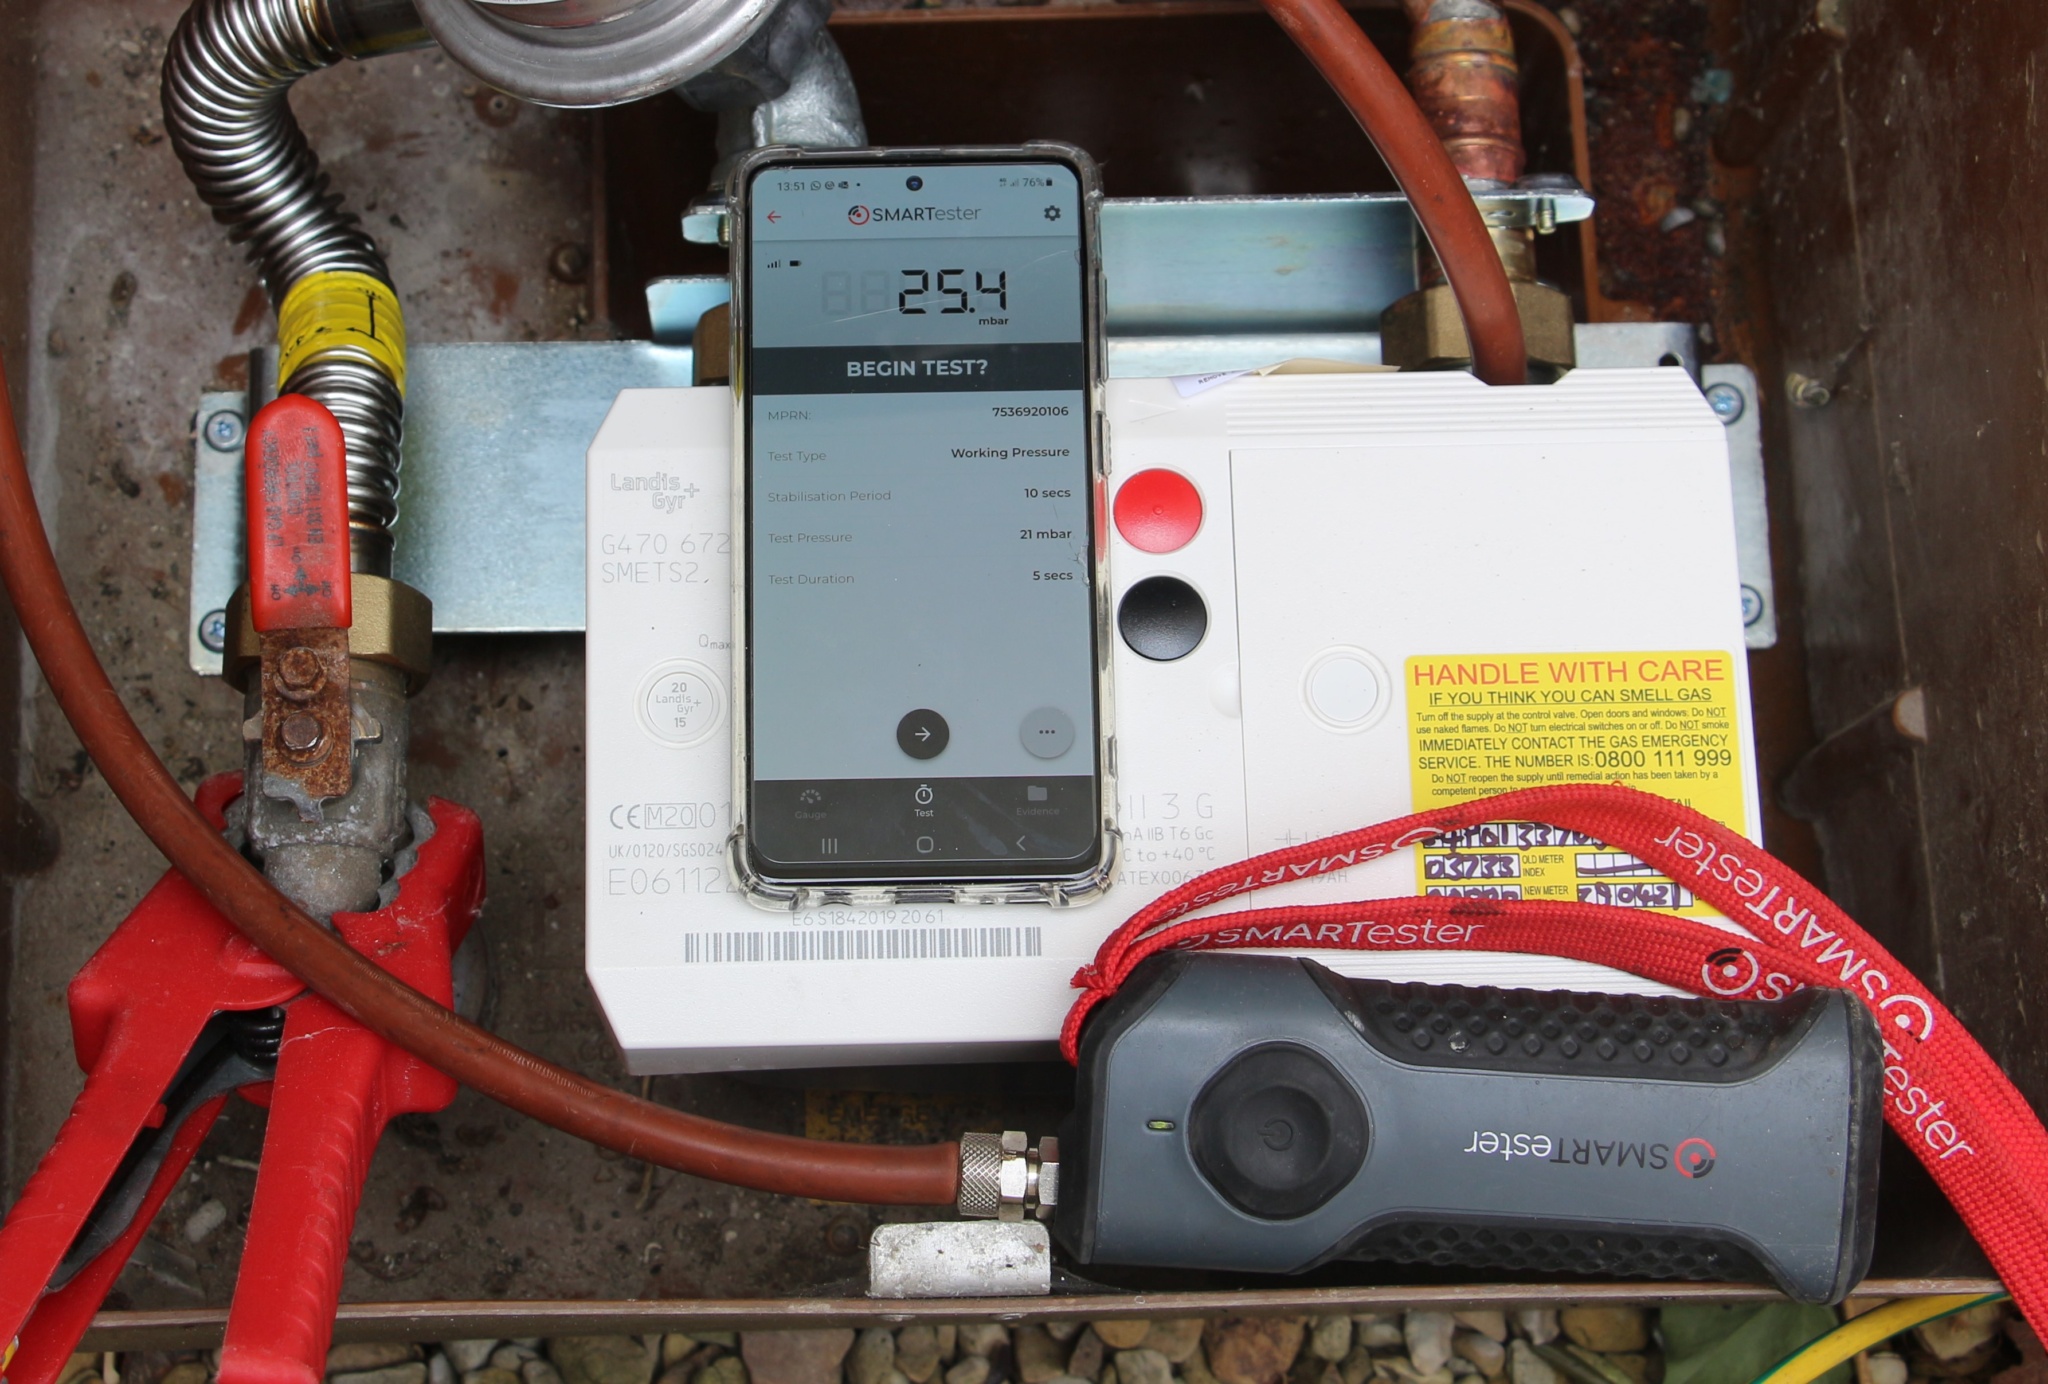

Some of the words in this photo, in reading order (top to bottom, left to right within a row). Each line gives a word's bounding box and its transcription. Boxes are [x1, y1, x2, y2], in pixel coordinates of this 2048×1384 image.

[777, 181, 806, 191] 13:51
[1022, 178, 1045, 187] 76%
[872, 206, 981, 222] SMARTester
[899, 269, 1007, 314] 25.4
[979, 317, 1009, 326] mbar
[847, 361, 916, 377] BEGIN
[922, 359, 988, 376] TEST?
[768, 411, 812, 420] MPRN:
[992, 407, 1069, 417] 7536920106
[768, 452, 794, 462] Test
[796, 451, 827, 463] Type
[951, 448, 1008, 460] Working
[1012, 447, 1070, 458] Pressure
[610, 472, 681, 491] Landis
[768, 492, 846, 502] Stabilisation
[850, 491, 891, 502] Period
[1024, 488, 1039, 498] 10
[1042, 490, 1071, 498] secs
[652, 492, 686, 514] Gyr
[768, 533, 795, 544] Test
[797, 532, 853, 543] Pressure
[1020, 530, 1033, 540] 21
[1036, 530, 1072, 539] mbar
[601, 533, 668, 555] G470
[768, 574, 795, 585] Test
[798, 573, 855, 584] Duration
[1033, 571, 1042, 581] 5
[1044, 572, 1073, 580] secs
[1414, 662, 1539, 686] HANDLE
[1549, 660, 1628, 684] WITH
[1638, 659, 1725, 682] CARE
[671, 682, 688, 693] 20
[656, 694, 692, 704] Landis
[1429, 692, 1443, 705] IF
[1448, 692, 1482, 705] YOU
[1488, 691, 1537, 704] THINK
[1540, 690, 1577, 704] YOU
[1581, 690, 1616, 703] CAN
[1620, 688, 1673, 702] SMELL
[1677, 688, 1712, 702] GAS
[1416, 712, 1435, 722] Turn
[1438, 712, 1448, 721] off
[1451, 712, 1464, 721] the
[1466, 712, 1494, 722] supply
[1496, 712, 1504, 720] at
[1506, 711, 1520, 720] the
[1522, 710, 1550, 720] control
[1552, 710, 1578, 719] valve.
[1580, 710, 1604, 719] Open
[1606, 709, 1630, 718] doors
[1632, 709, 1648, 718] and
[1692, 708, 1704, 716] Do
[1706, 707, 1726, 717] NOT
[674, 718, 687, 728] 15
[1416, 726, 1431, 734] use
[1434, 724, 1459, 734] naked
[1462, 724, 1491, 733] flames.
[1494, 724, 1506, 732] Do
[1508, 723, 1528, 732] NOT
[1530, 724, 1546, 732] turn
[1549, 722, 1586, 732] electrical
[1588, 722, 1624, 730] switches
[1626, 722, 1638, 730] on
[1640, 722, 1648, 730] or
[1650, 721, 1663, 730] off.
[1665, 720, 1678, 730] Do
[1680, 720, 1700, 730] NOT
[1702, 720, 1730, 728] smoke
[1419, 737, 1508, 752] IMMEDIATELY
[1512, 736, 1575, 750] CONTACT
[1579, 736, 1606, 748] THE
[1610, 735, 1638, 748] GAS
[1642, 734, 1728, 748] EMERGENCY
[1418, 756, 1481, 770] SERVICE.
[1484, 756, 1512, 768] THE
[1516, 754, 1574, 768] NUMBER
[1595, 750, 1646, 768] 0800
[1654, 750, 1685, 767] 111
[1694, 749, 1732, 766] 999
[1432, 774, 1444, 783] Do
[1446, 774, 1466, 784] NOT
[1468, 774, 1498, 784] reopen
[1500, 773, 1514, 782] the
[1516, 772, 1544, 783] supply
[1546, 772, 1564, 781] until
[1566, 772, 1603, 780] remedial
[1605, 772, 1630, 780] action
[1632, 771, 1648, 780] has
[1650, 770, 1672, 780] been
[1674, 770, 1698, 779] taken
[1700, 770, 1710, 780] by
[1432, 787, 1477, 796] competent
[1016, 807, 1060, 816] Evidence
[1162, 793, 1180, 820] 3
[1196, 792, 1213, 819] G
[794, 810, 827, 821] Gauge
[914, 808, 934, 818] Test
[1138, 848, 1157, 862] to
[1522, 855, 1537, 865] OLD
[1538, 854, 1564, 864] METER
[1523, 868, 1546, 877] INDEX
[1153, 843, 1386, 921] SMARTeste
[1524, 887, 1541, 896] NEW
[1543, 886, 1568, 895] METER
[1654, 826, 1888, 999] SMARTester
[1213, 918, 1484, 945] SMARTester
[1464, 1130, 1669, 1170] SMARTester
